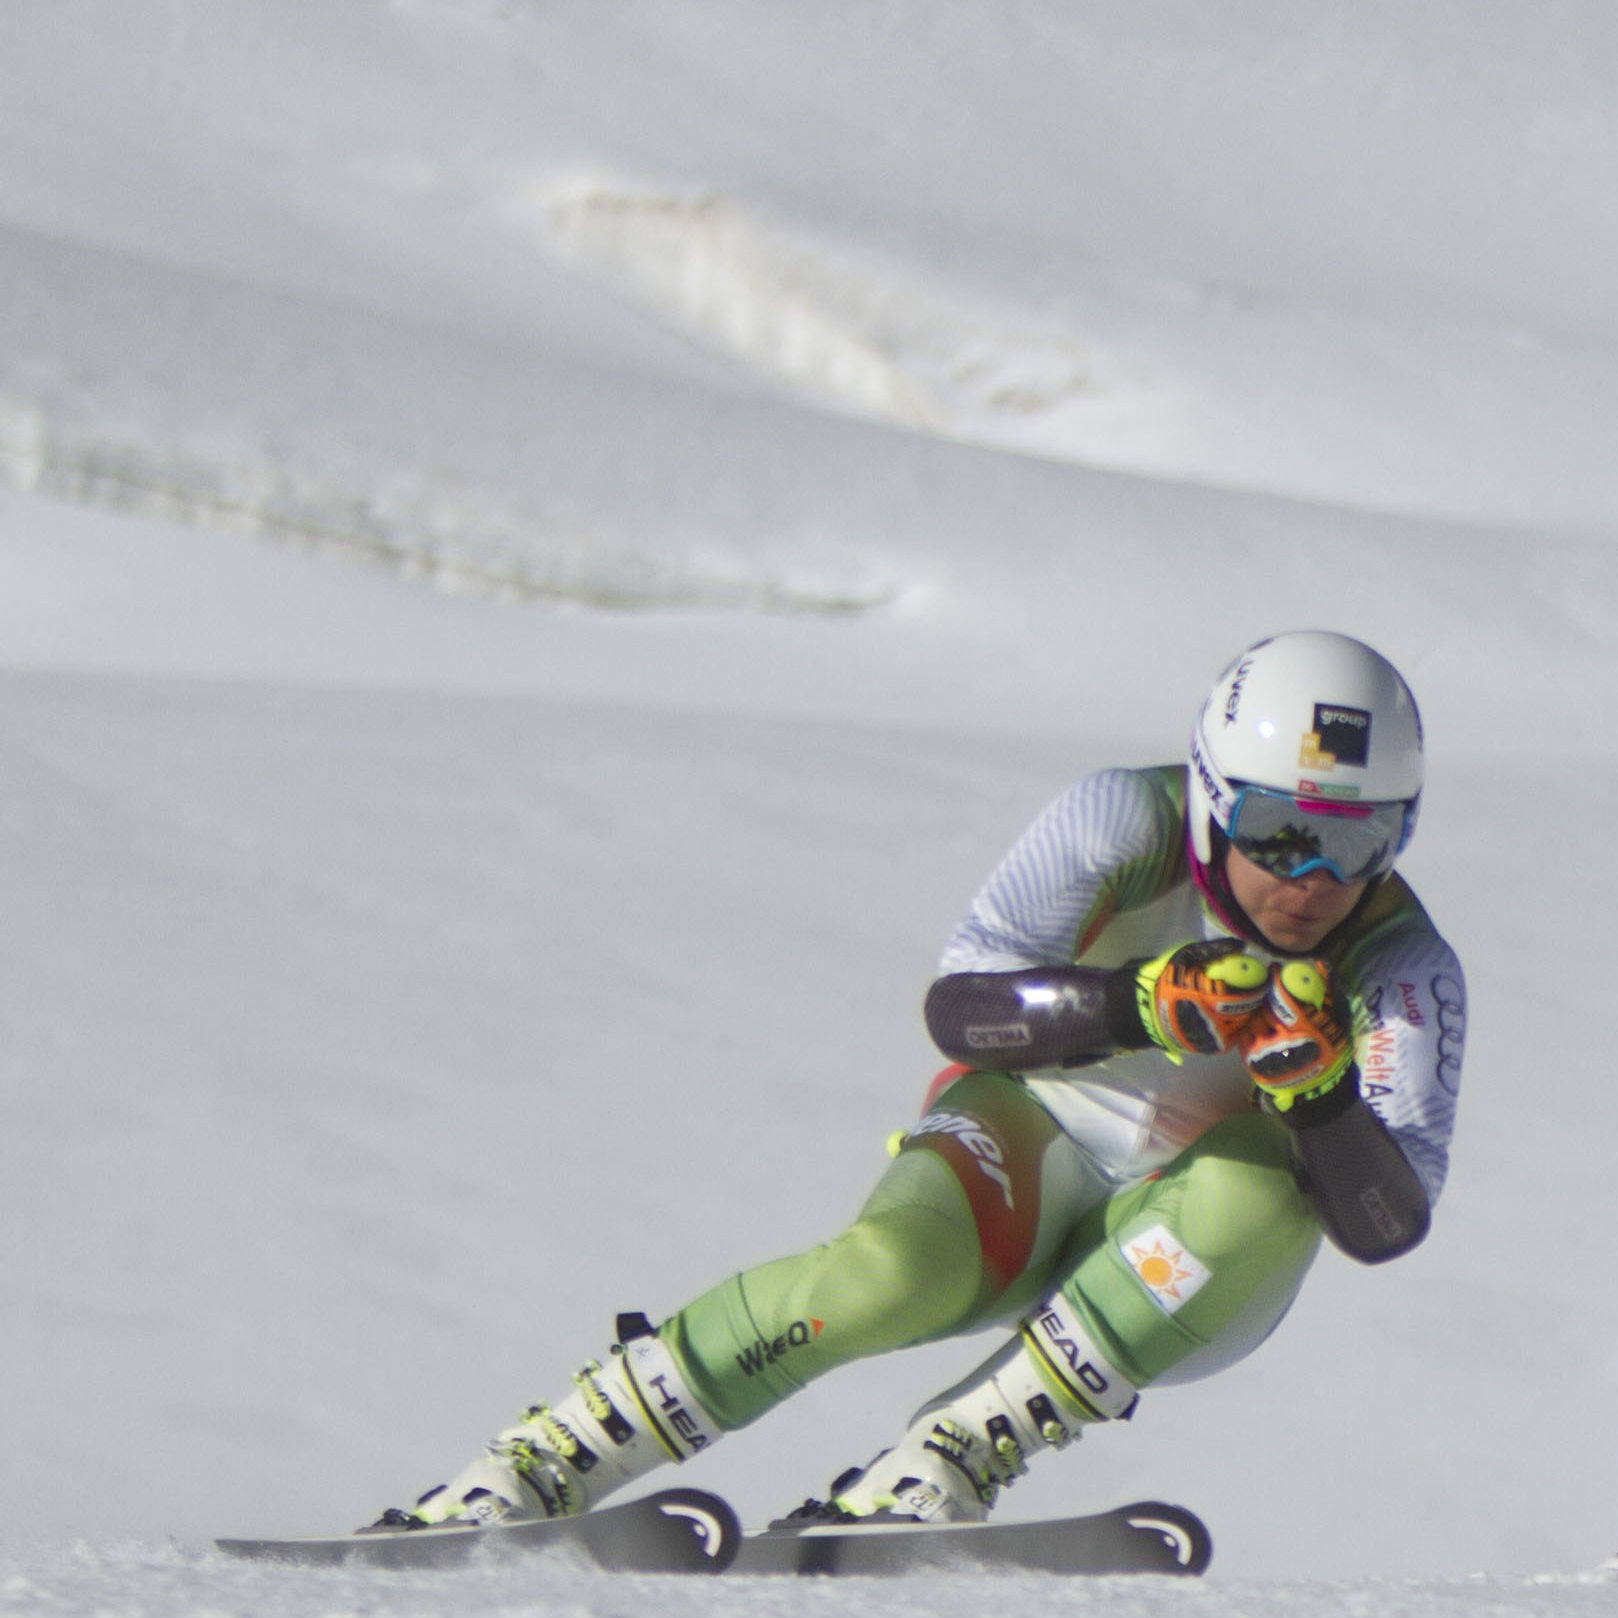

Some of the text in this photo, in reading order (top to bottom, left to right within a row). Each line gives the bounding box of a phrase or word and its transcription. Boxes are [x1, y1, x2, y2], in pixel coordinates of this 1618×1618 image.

[1223, 660, 1253, 729] uvex
[1320, 710, 1367, 729] group
[1398, 982, 1425, 1027] Audi
[648, 1374, 711, 1453] HEA
